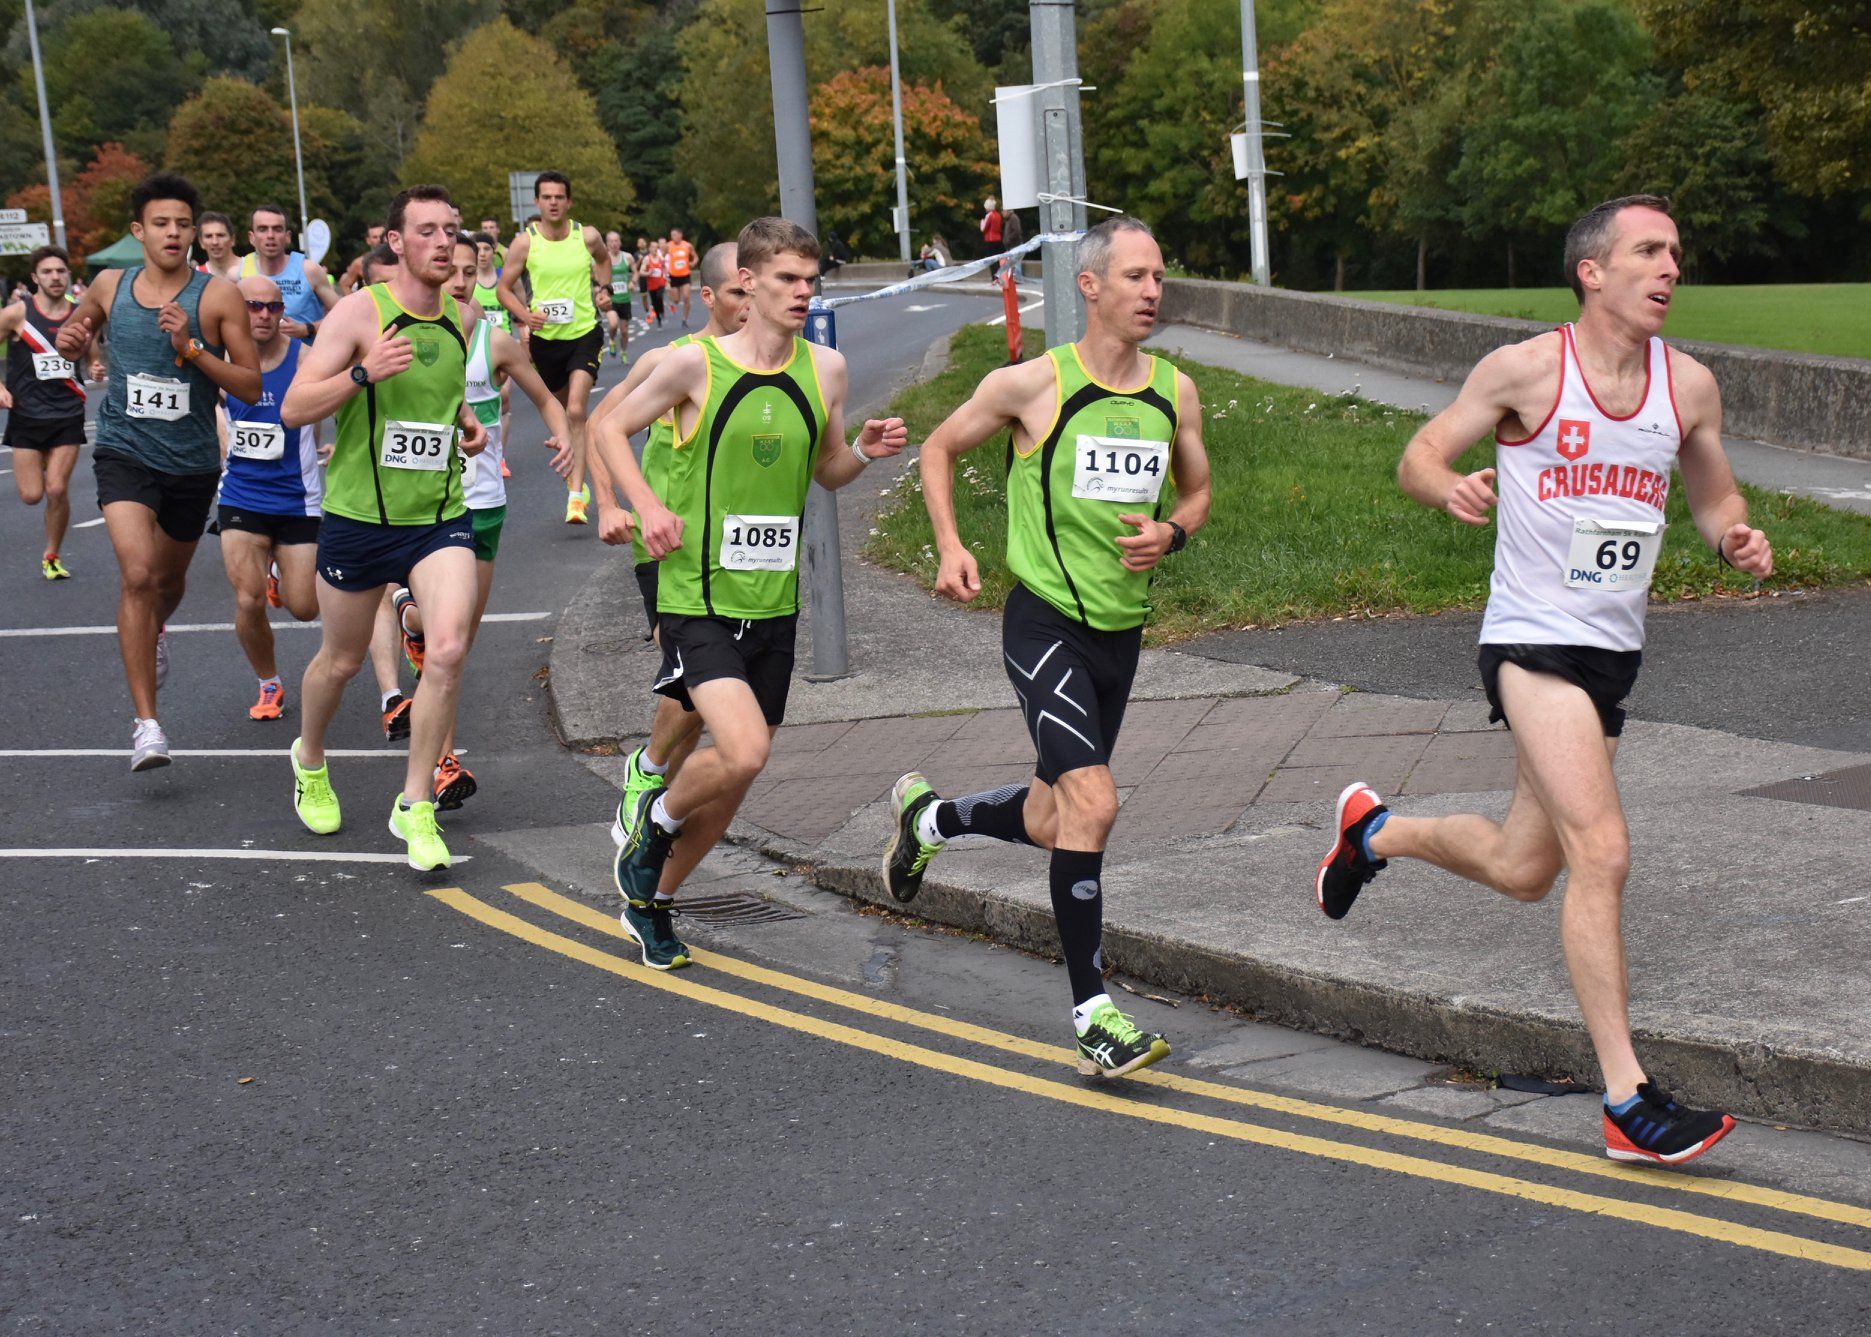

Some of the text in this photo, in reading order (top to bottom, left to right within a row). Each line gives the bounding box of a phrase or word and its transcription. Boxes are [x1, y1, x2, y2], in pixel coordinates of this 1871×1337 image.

[543, 306, 568, 317] 952
[40, 361, 72, 371] 236
[132, 389, 179, 410] 141
[235, 430, 275, 449] 507
[391, 433, 442, 457] 303
[385, 455, 407, 464] DNG
[1085, 449, 1160, 477] 1104
[1107, 486, 1149, 494] myrunresults
[730, 526, 792, 548] 1085
[1575, 527, 1622, 537] Rathfarnham
[1595, 540, 1641, 571] 69
[1569, 568, 1602, 583] DNG
